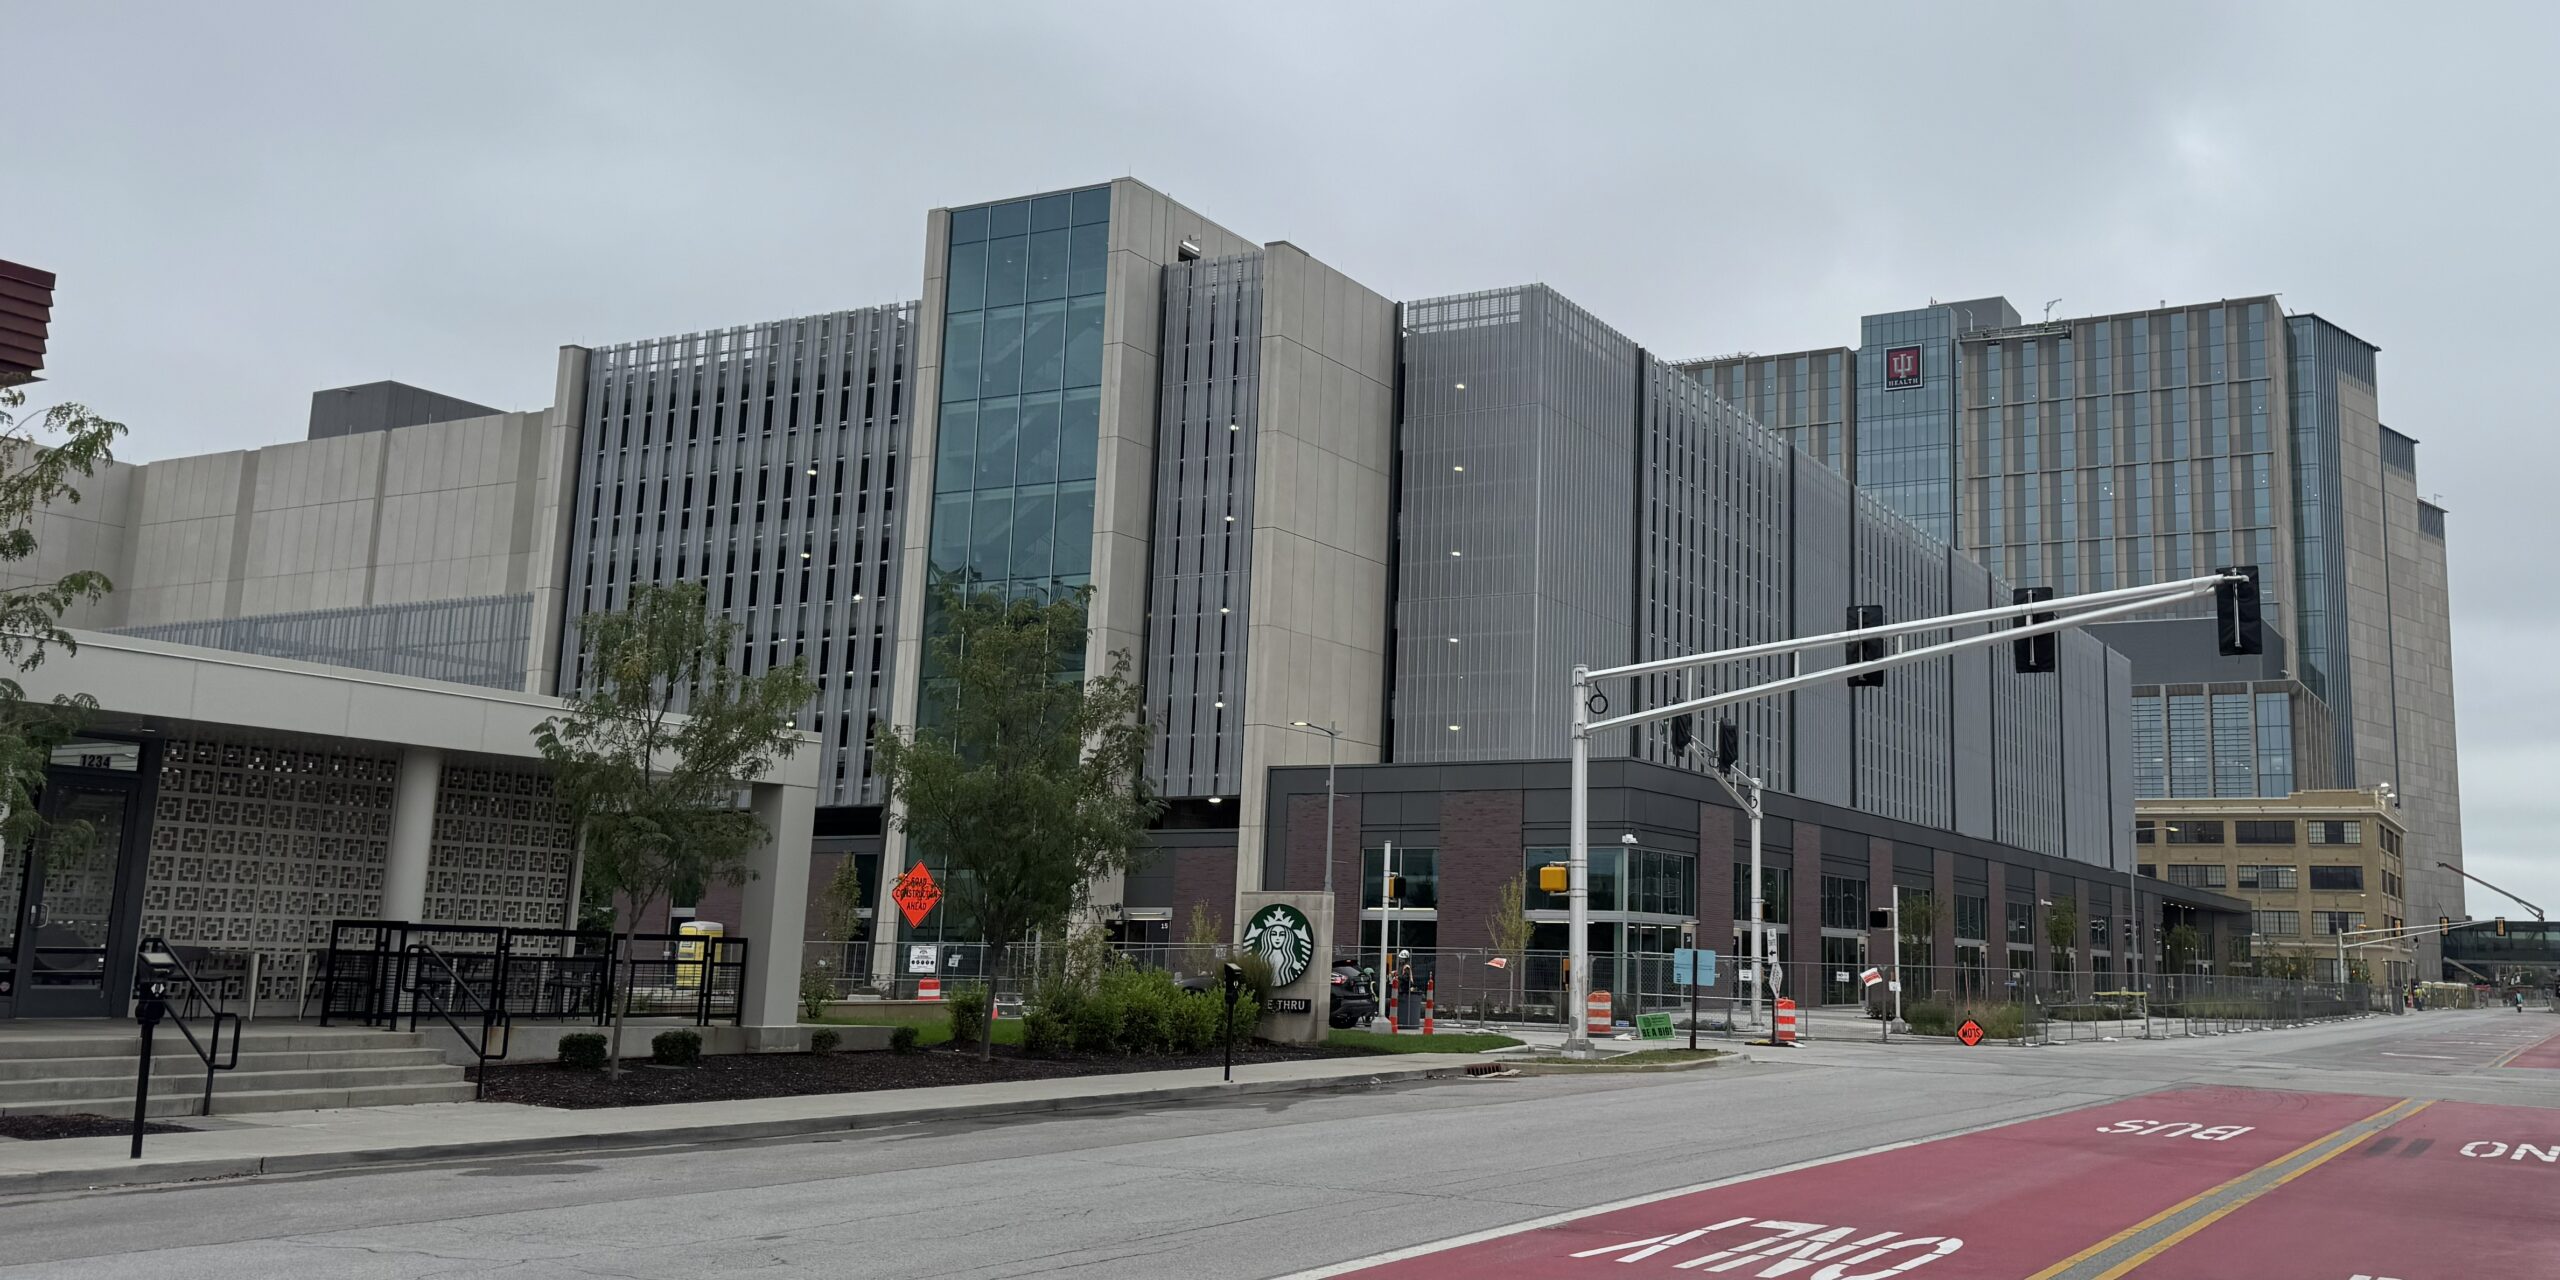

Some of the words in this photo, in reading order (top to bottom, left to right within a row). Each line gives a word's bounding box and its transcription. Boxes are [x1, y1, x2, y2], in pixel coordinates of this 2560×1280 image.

[1888, 378, 1919, 386] HEALTH
[81, 754, 111, 768] 1234
[907, 901, 926, 910] AHEAD
[1278, 1000, 1305, 1010] THRU
[1642, 1028, 1651, 1037] BE
[1652, 1028, 1657, 1037] A
[1962, 1028, 1981, 1038] SLOW
[2096, 1120, 2256, 1141] BUS
[1569, 1216, 1963, 1280] ONLY
